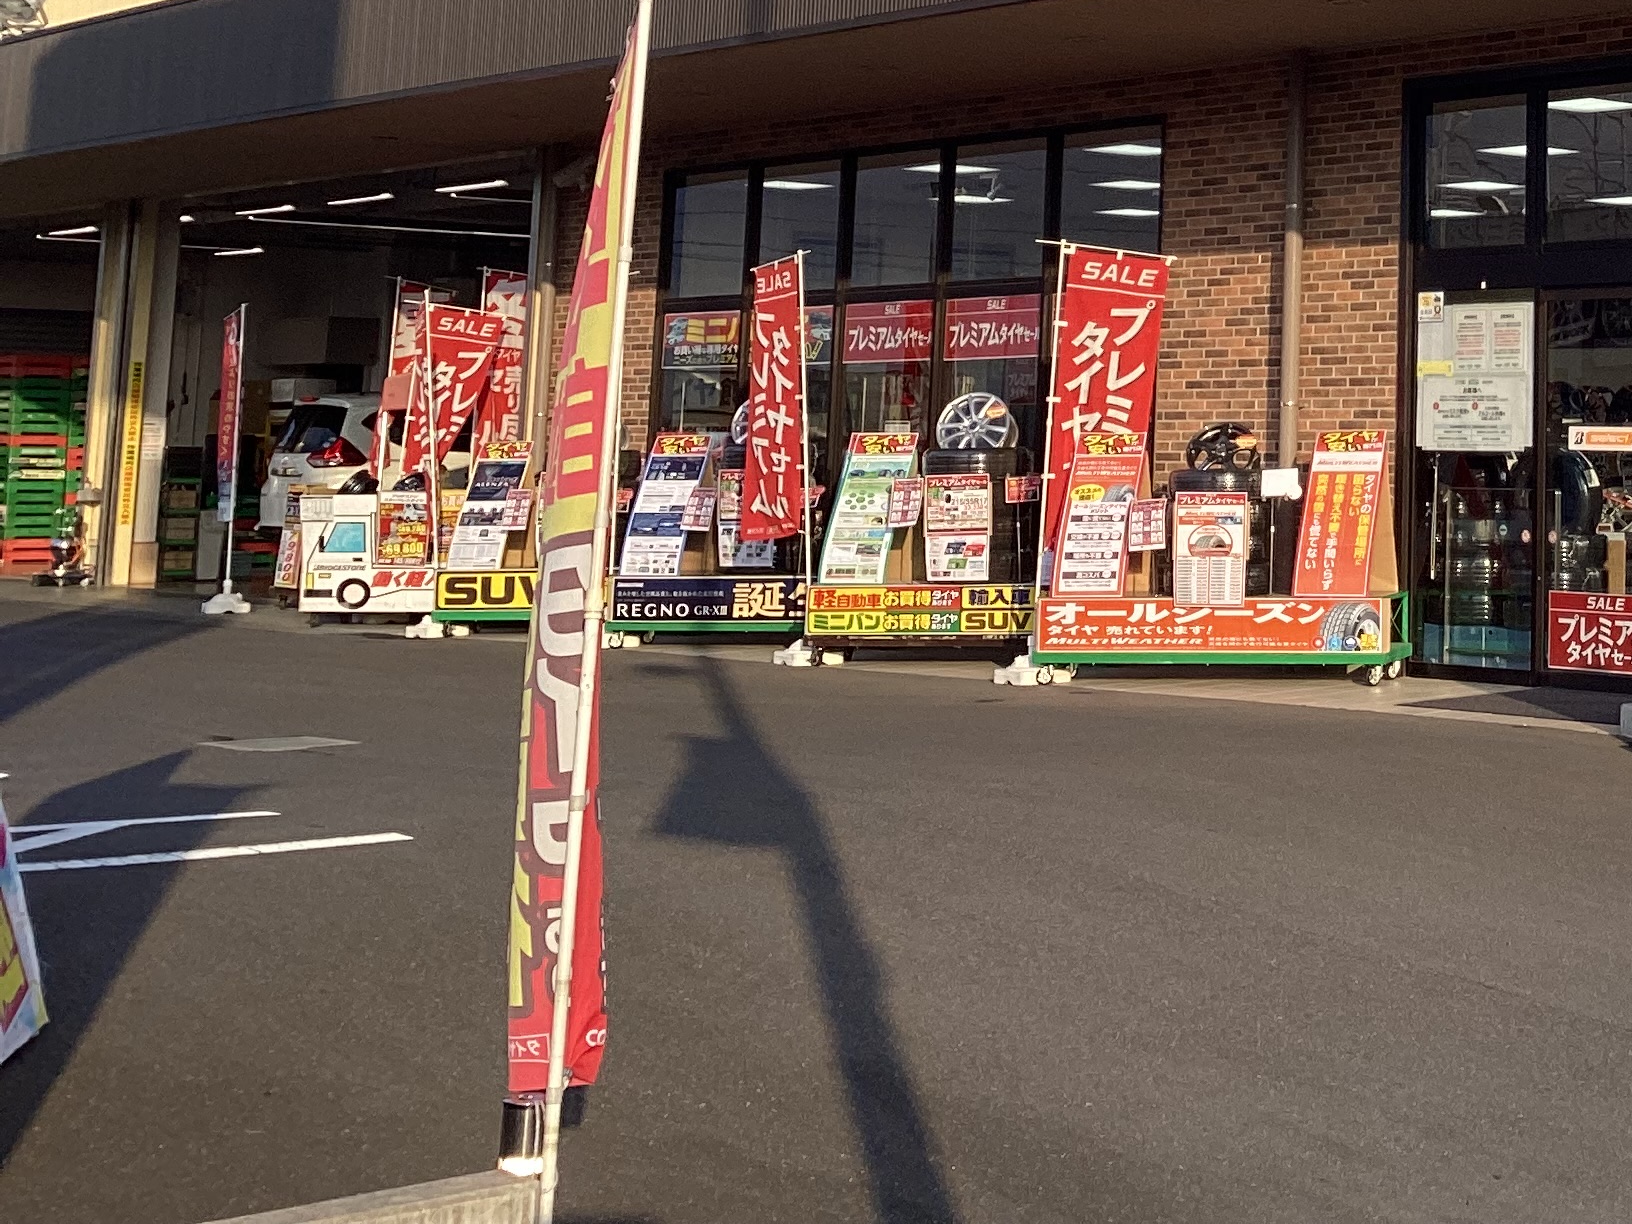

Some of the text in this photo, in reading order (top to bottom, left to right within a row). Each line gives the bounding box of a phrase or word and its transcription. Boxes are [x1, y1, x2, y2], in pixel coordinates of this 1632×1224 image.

[1081, 261, 1159, 287] SALE
[884, 304, 900, 315] SALE
[986, 299, 1006, 310] SALE
[437, 316, 497, 338] SALE
[814, 589, 931, 608] 軽自動車 お買得
[968, 589, 1031, 606] 輸入車
[1586, 597, 1626, 611] SALE
[616, 603, 690, 618] REGNO
[1045, 602, 1326, 624] オールシーズン
[814, 614, 931, 631] ミニバン お買得
[966, 612, 1032, 630] SUV
[1047, 624, 1213, 636] タイヤ 売れています!
[1045, 637, 1203, 645] MULTIWEATHER
